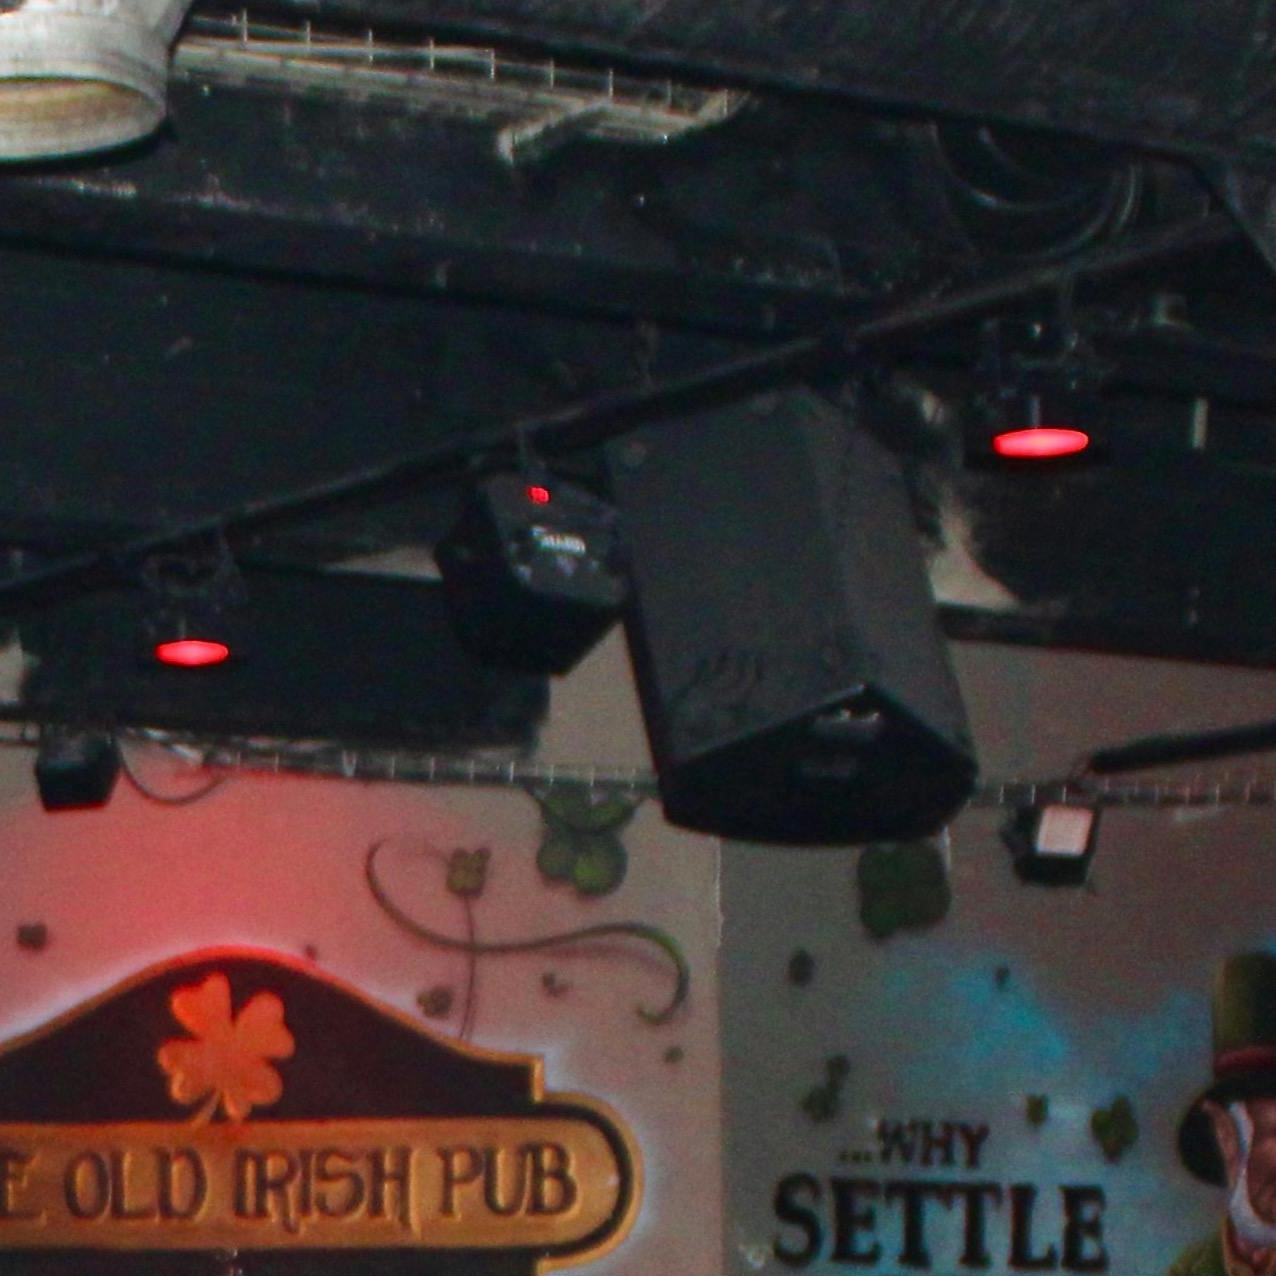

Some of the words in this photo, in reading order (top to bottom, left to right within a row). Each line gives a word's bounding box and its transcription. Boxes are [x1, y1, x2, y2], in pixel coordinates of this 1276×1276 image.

[62, 1146, 208, 1219] OLD
[232, 1145, 416, 1236] IRISH
[437, 1141, 578, 1217] PUB
[772, 1172, 1111, 1272] SETTLE
